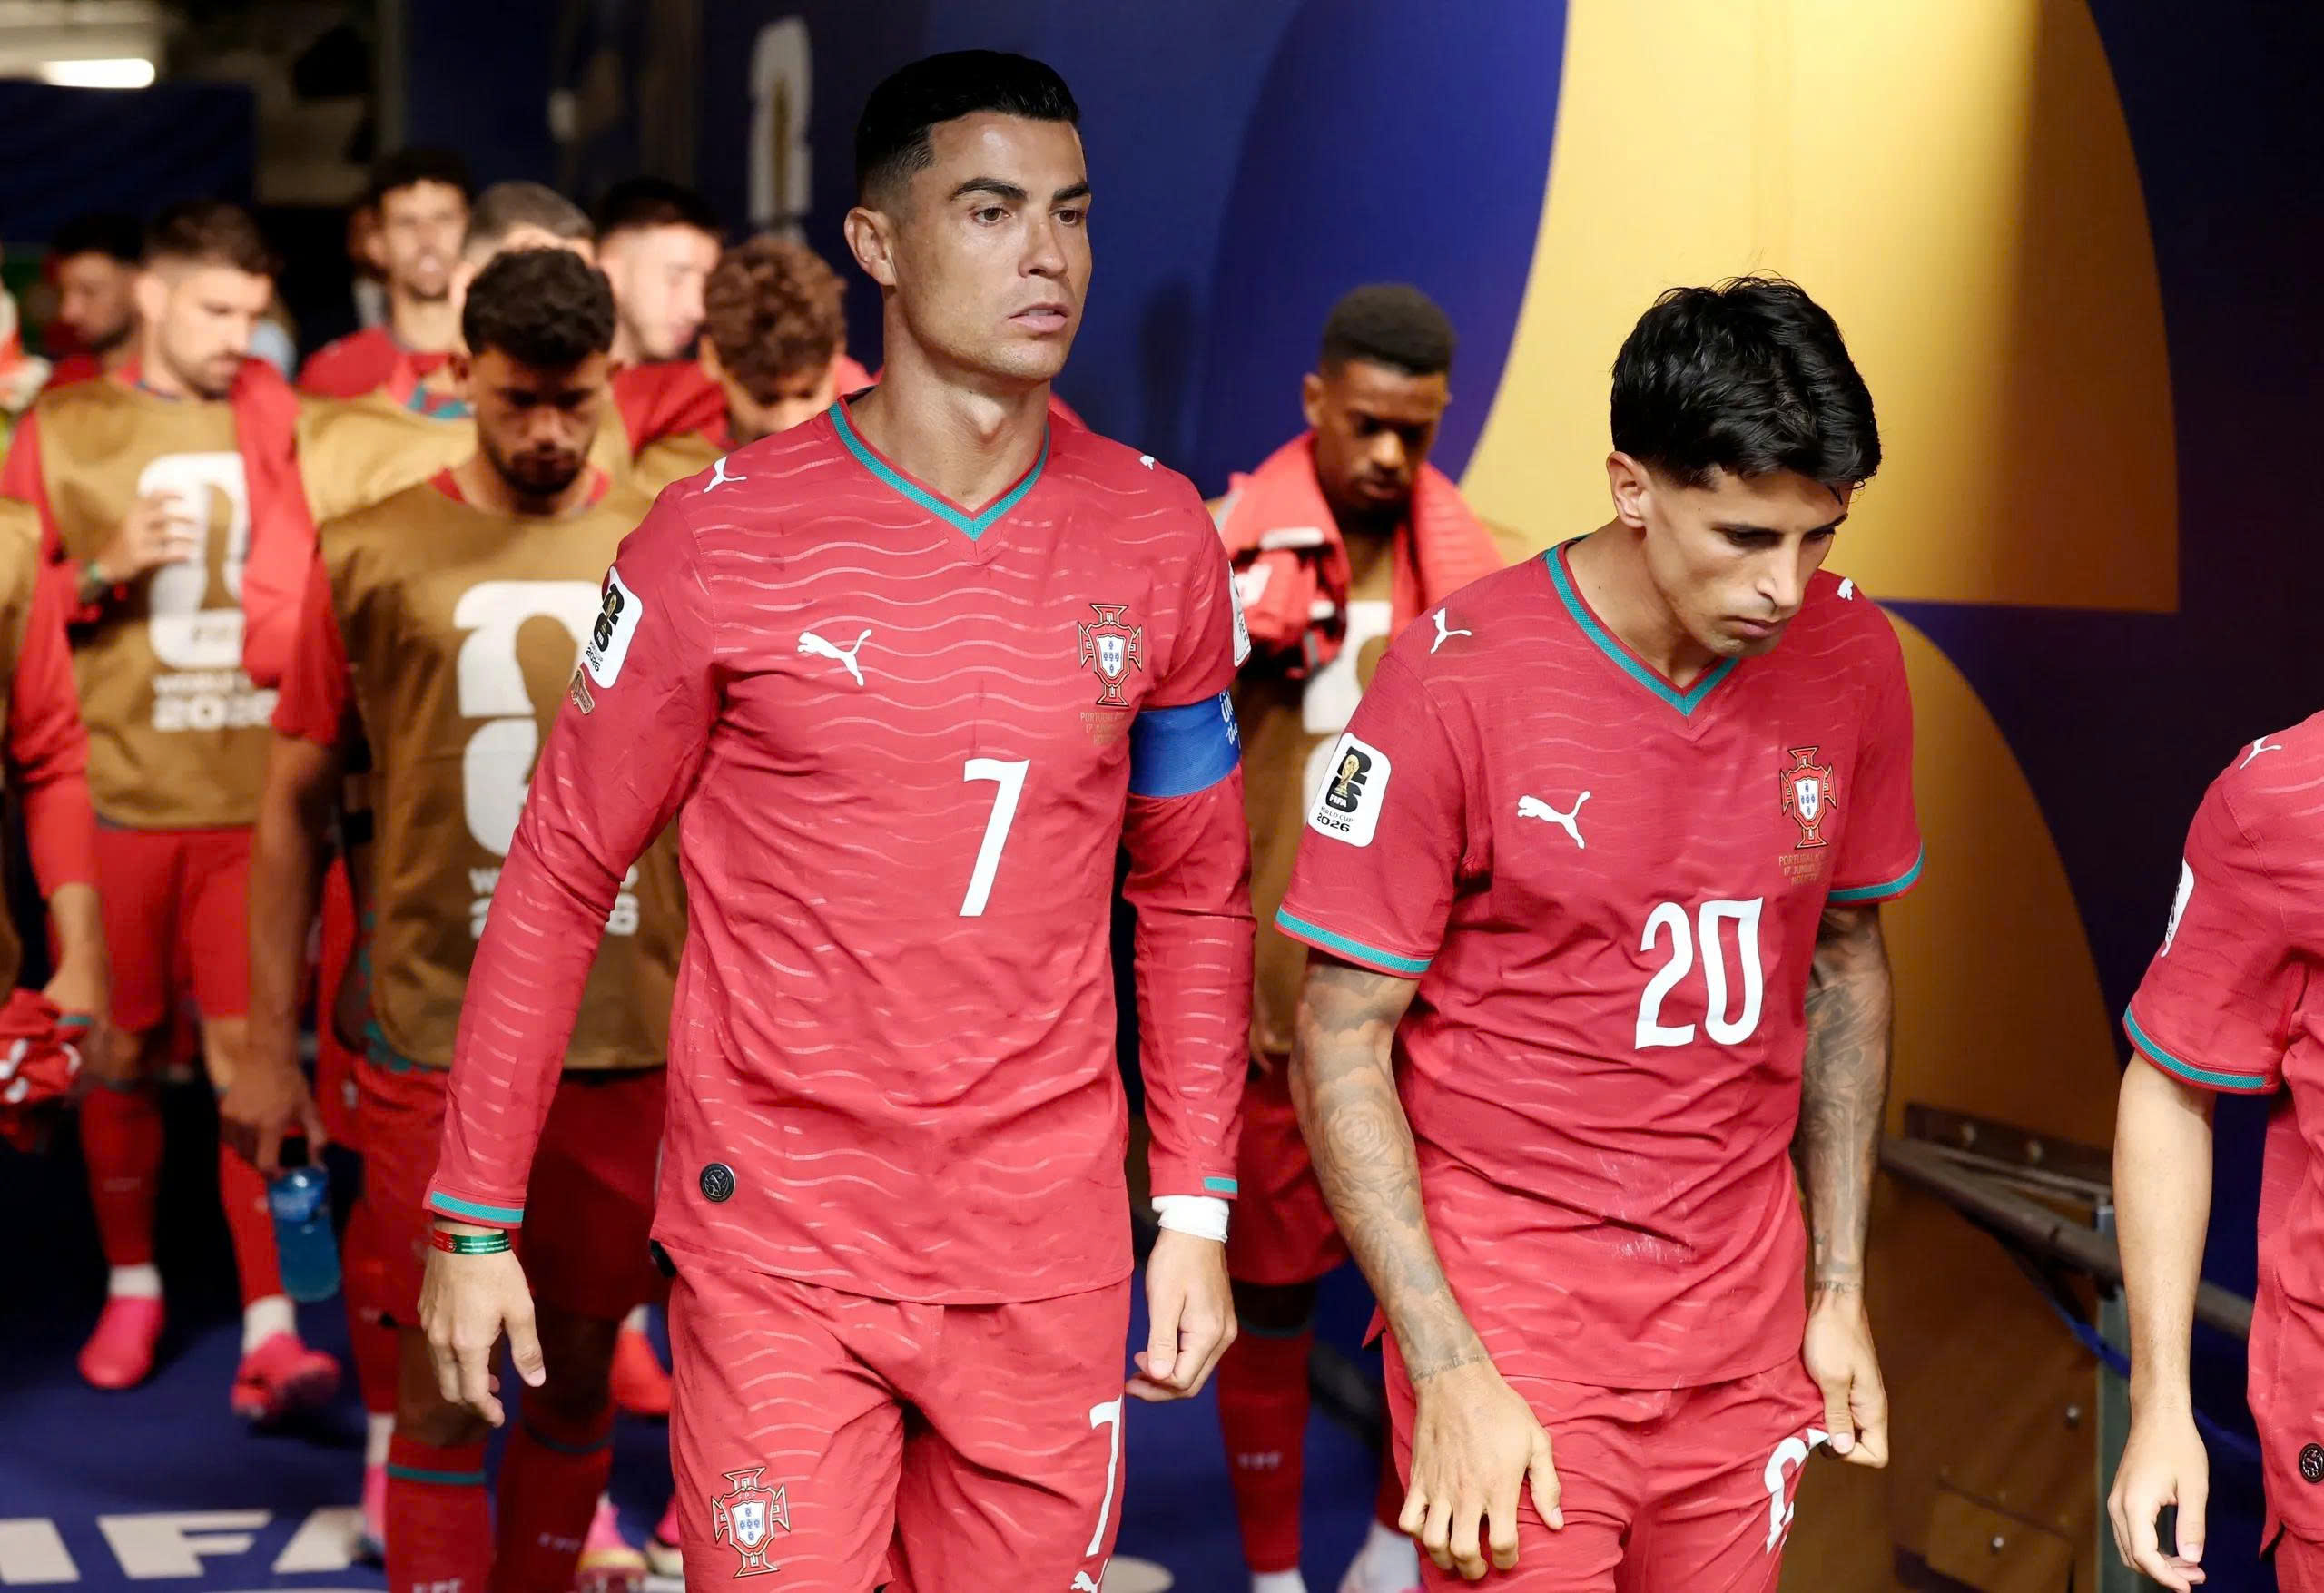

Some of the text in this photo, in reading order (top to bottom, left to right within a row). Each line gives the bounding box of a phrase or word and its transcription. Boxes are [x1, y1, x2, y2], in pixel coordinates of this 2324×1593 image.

[586, 647, 600, 672] 2026
[959, 758, 1031, 917] 7
[1316, 812, 1351, 832] 2026
[1329, 793, 1348, 808] FIFA
[1634, 897, 1764, 1050] 20
[1085, 1394, 1123, 1557] 7
